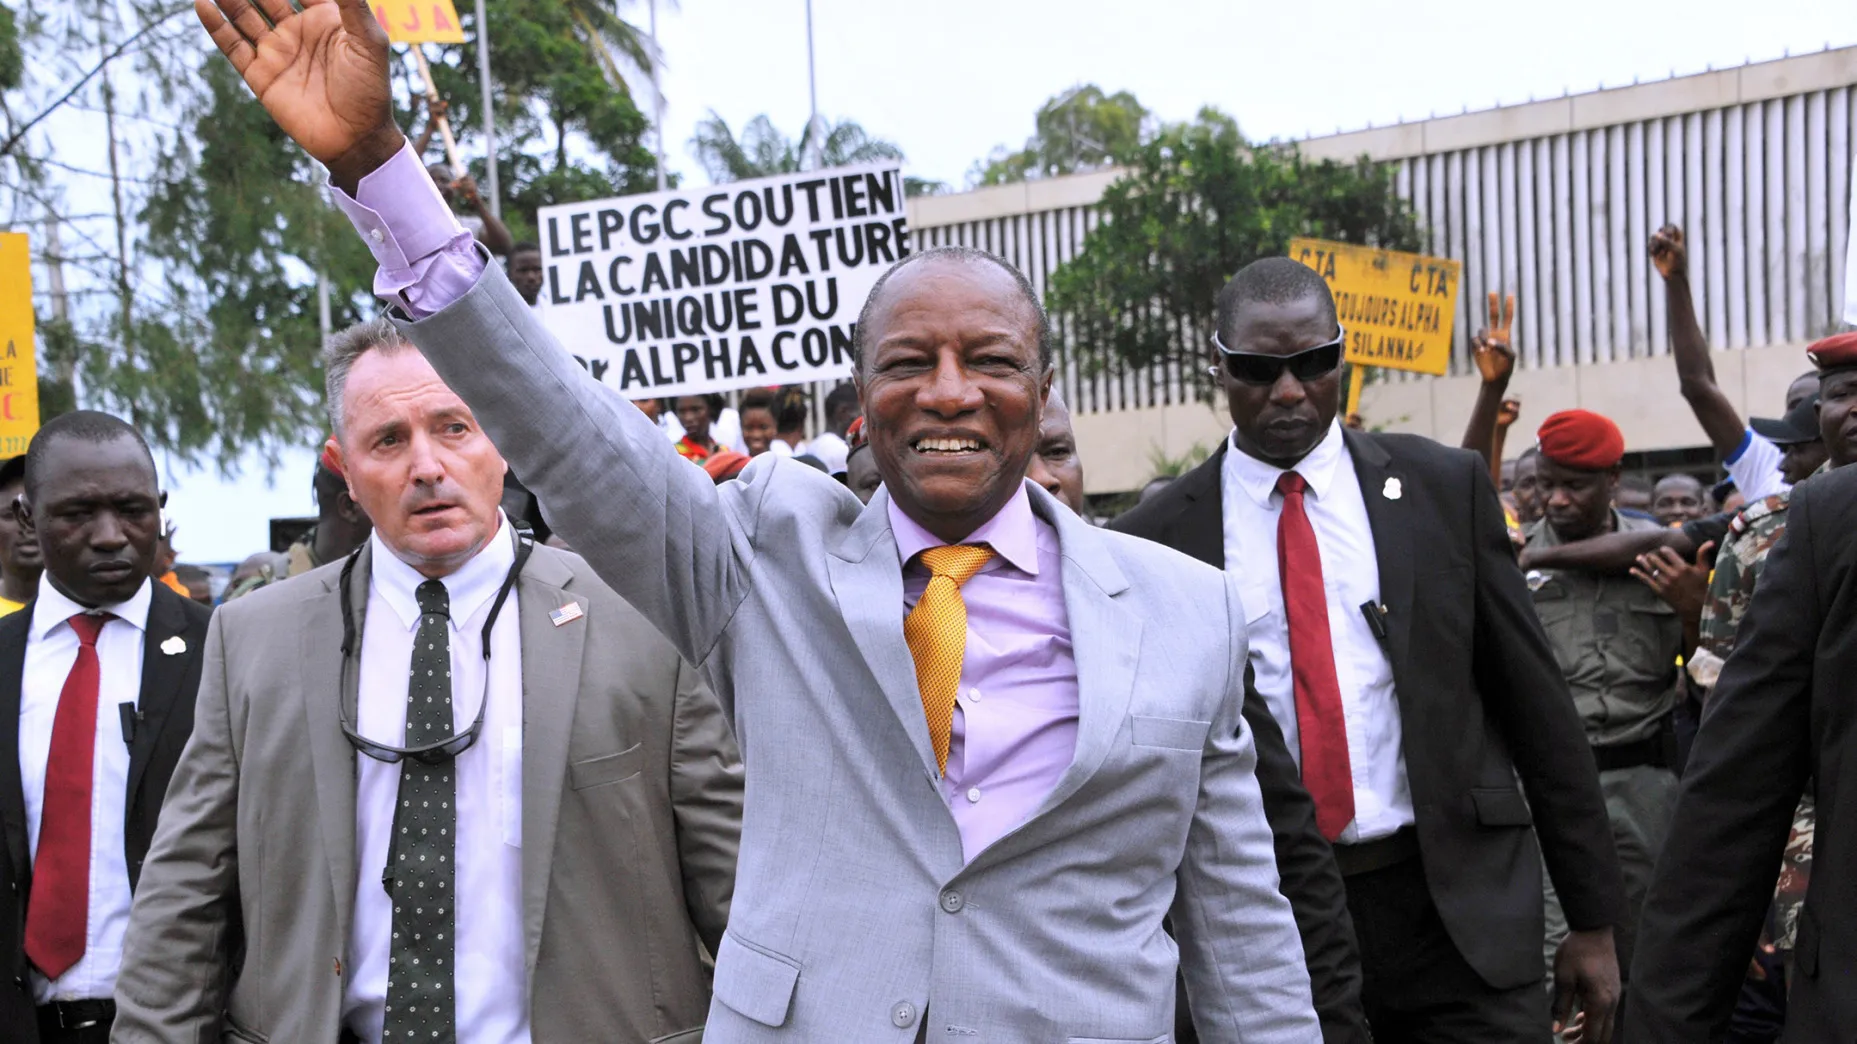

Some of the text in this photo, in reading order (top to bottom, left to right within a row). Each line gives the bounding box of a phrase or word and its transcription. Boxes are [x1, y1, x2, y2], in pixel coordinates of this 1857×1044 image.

[548, 217, 910, 305] LA CANDIDATURE
[1410, 263, 1448, 298] CTA
[603, 277, 838, 345] UNIQUE DU
[1399, 302, 1440, 334] ALPHA
[620, 335, 767, 390] ALPHA
